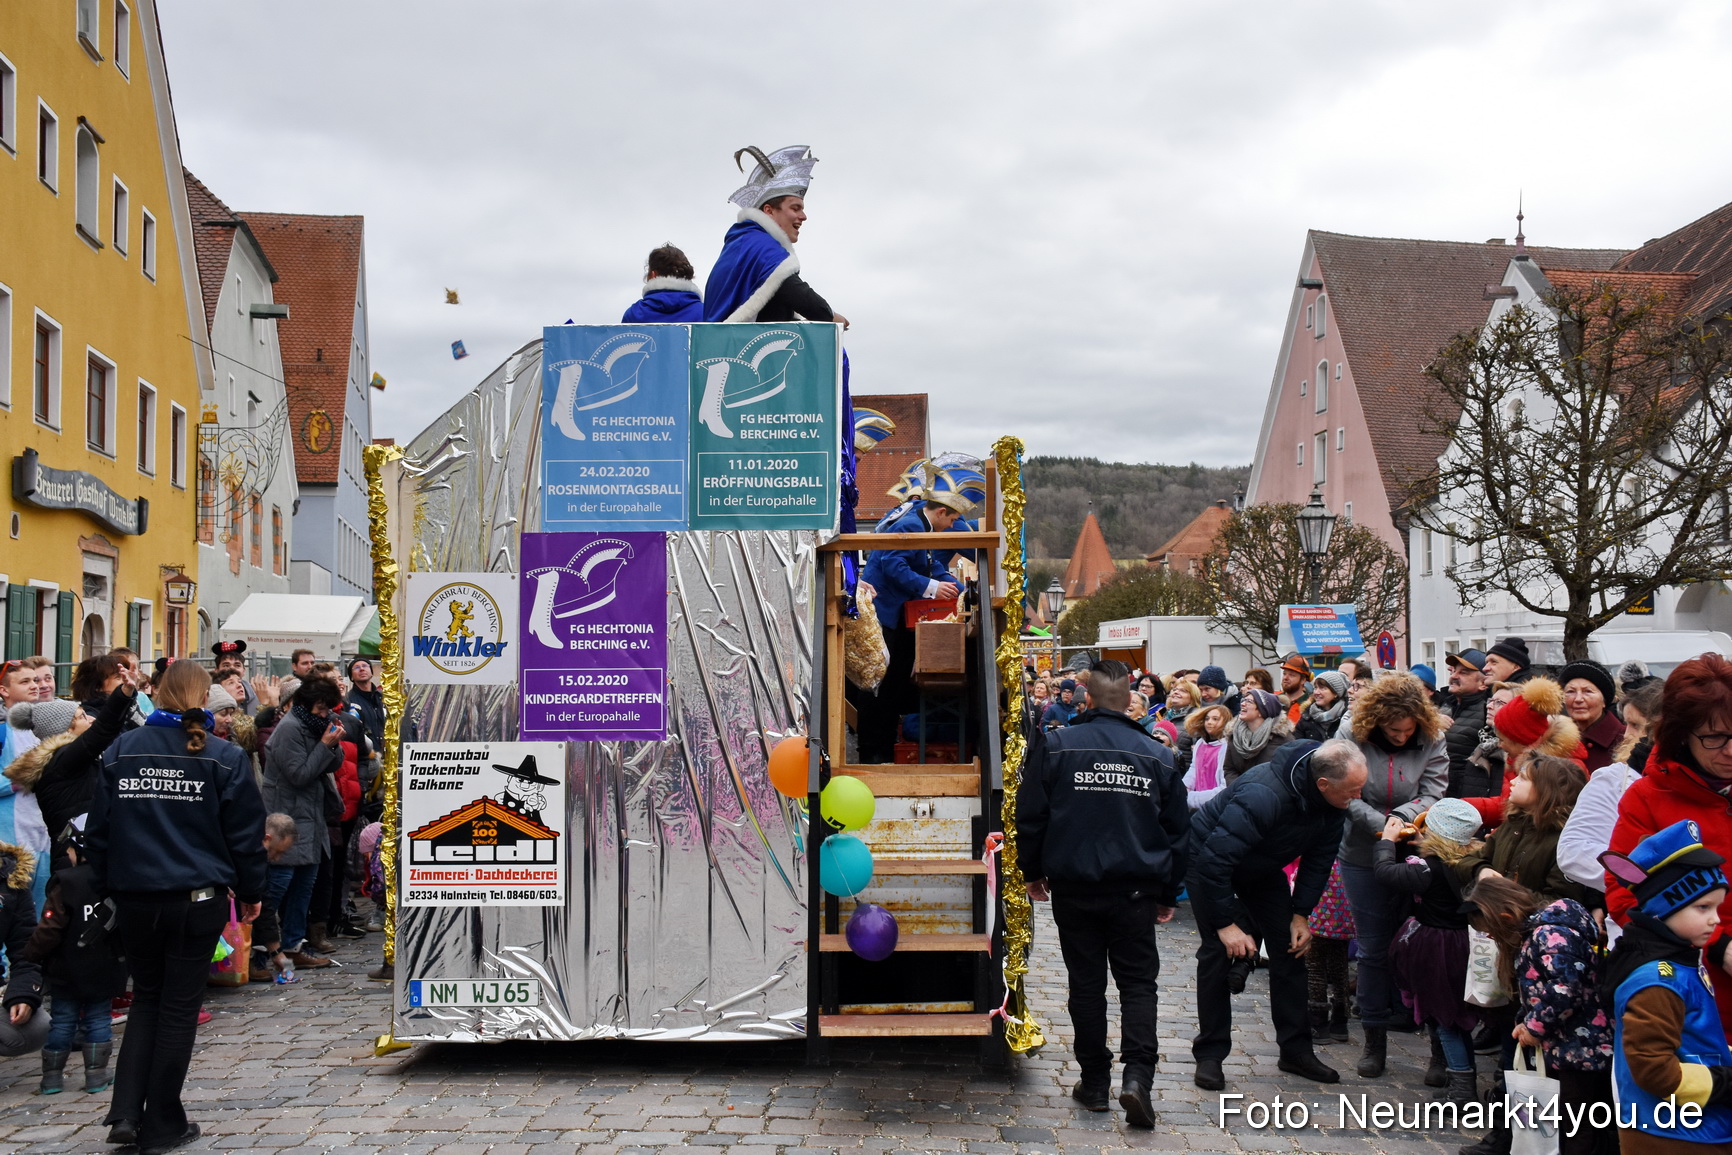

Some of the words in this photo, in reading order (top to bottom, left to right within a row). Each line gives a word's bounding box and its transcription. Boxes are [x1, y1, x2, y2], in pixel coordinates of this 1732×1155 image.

[592, 416, 608, 426] FG
[609, 416, 676, 426] HECHTONIA
[740, 414, 756, 424] FG
[757, 414, 823, 424] HECHTONIA
[592, 431, 650, 442] BERCHING
[652, 431, 672, 441] e.V.
[740, 429, 798, 440] BERCHING
[800, 429, 820, 439] e.V.
[728, 459, 799, 470] 11.01.2020
[579, 466, 650, 477] 24.02.2020
[703, 475, 823, 488] ERÖFFNUNGSBALL
[548, 484, 682, 495] ROSENMONTAGSBALL
[35, 465, 74, 502] Brauerei
[75, 477, 108, 515] Gasthof
[108, 493, 136, 528] Winkler
[709, 495, 720, 506] in
[723, 495, 742, 506] der
[746, 494, 816, 509] Europahalle
[567, 502, 577, 512] in
[580, 502, 597, 512] der
[600, 502, 662, 515] Europahalle
[423, 585, 470, 632] WINKLERBRÄU
[471, 590, 497, 633] BERCHING
[570, 624, 585, 634] FG
[588, 624, 654, 634] HECHTONIA
[1108, 626, 1122, 638] Imbiss
[1123, 625, 1140, 637] Krämer
[412, 635, 508, 657] Winkler
[570, 640, 628, 650] BERCHING
[630, 640, 650, 650] e.V.
[558, 675, 629, 686] 15.02.2020
[525, 692, 662, 705] KINDERGARDETREFFEN
[546, 712, 556, 722] in
[559, 711, 575, 722] der
[579, 711, 640, 725] Europahalle
[410, 749, 489, 761] Innenausbau
[139, 768, 184, 778] CONSEC
[410, 764, 480, 775] Trockenbau
[1093, 762, 1134, 773] CONSEC
[118, 778, 205, 793] SECURITY
[409, 779, 464, 790] Balkone
[1074, 771, 1152, 789] SECURITY
[1073, 786, 1151, 797] www.consec-nuernberg.de
[118, 793, 204, 802] www.consec-nuernberg.de
[472, 829, 498, 837] 100
[410, 869, 469, 880] Zimmerei
[475, 868, 558, 880] Dachdeckerei
[409, 891, 438, 900] 92334
[441, 890, 486, 900] Holnstein
[430, 983, 457, 1003] NM
